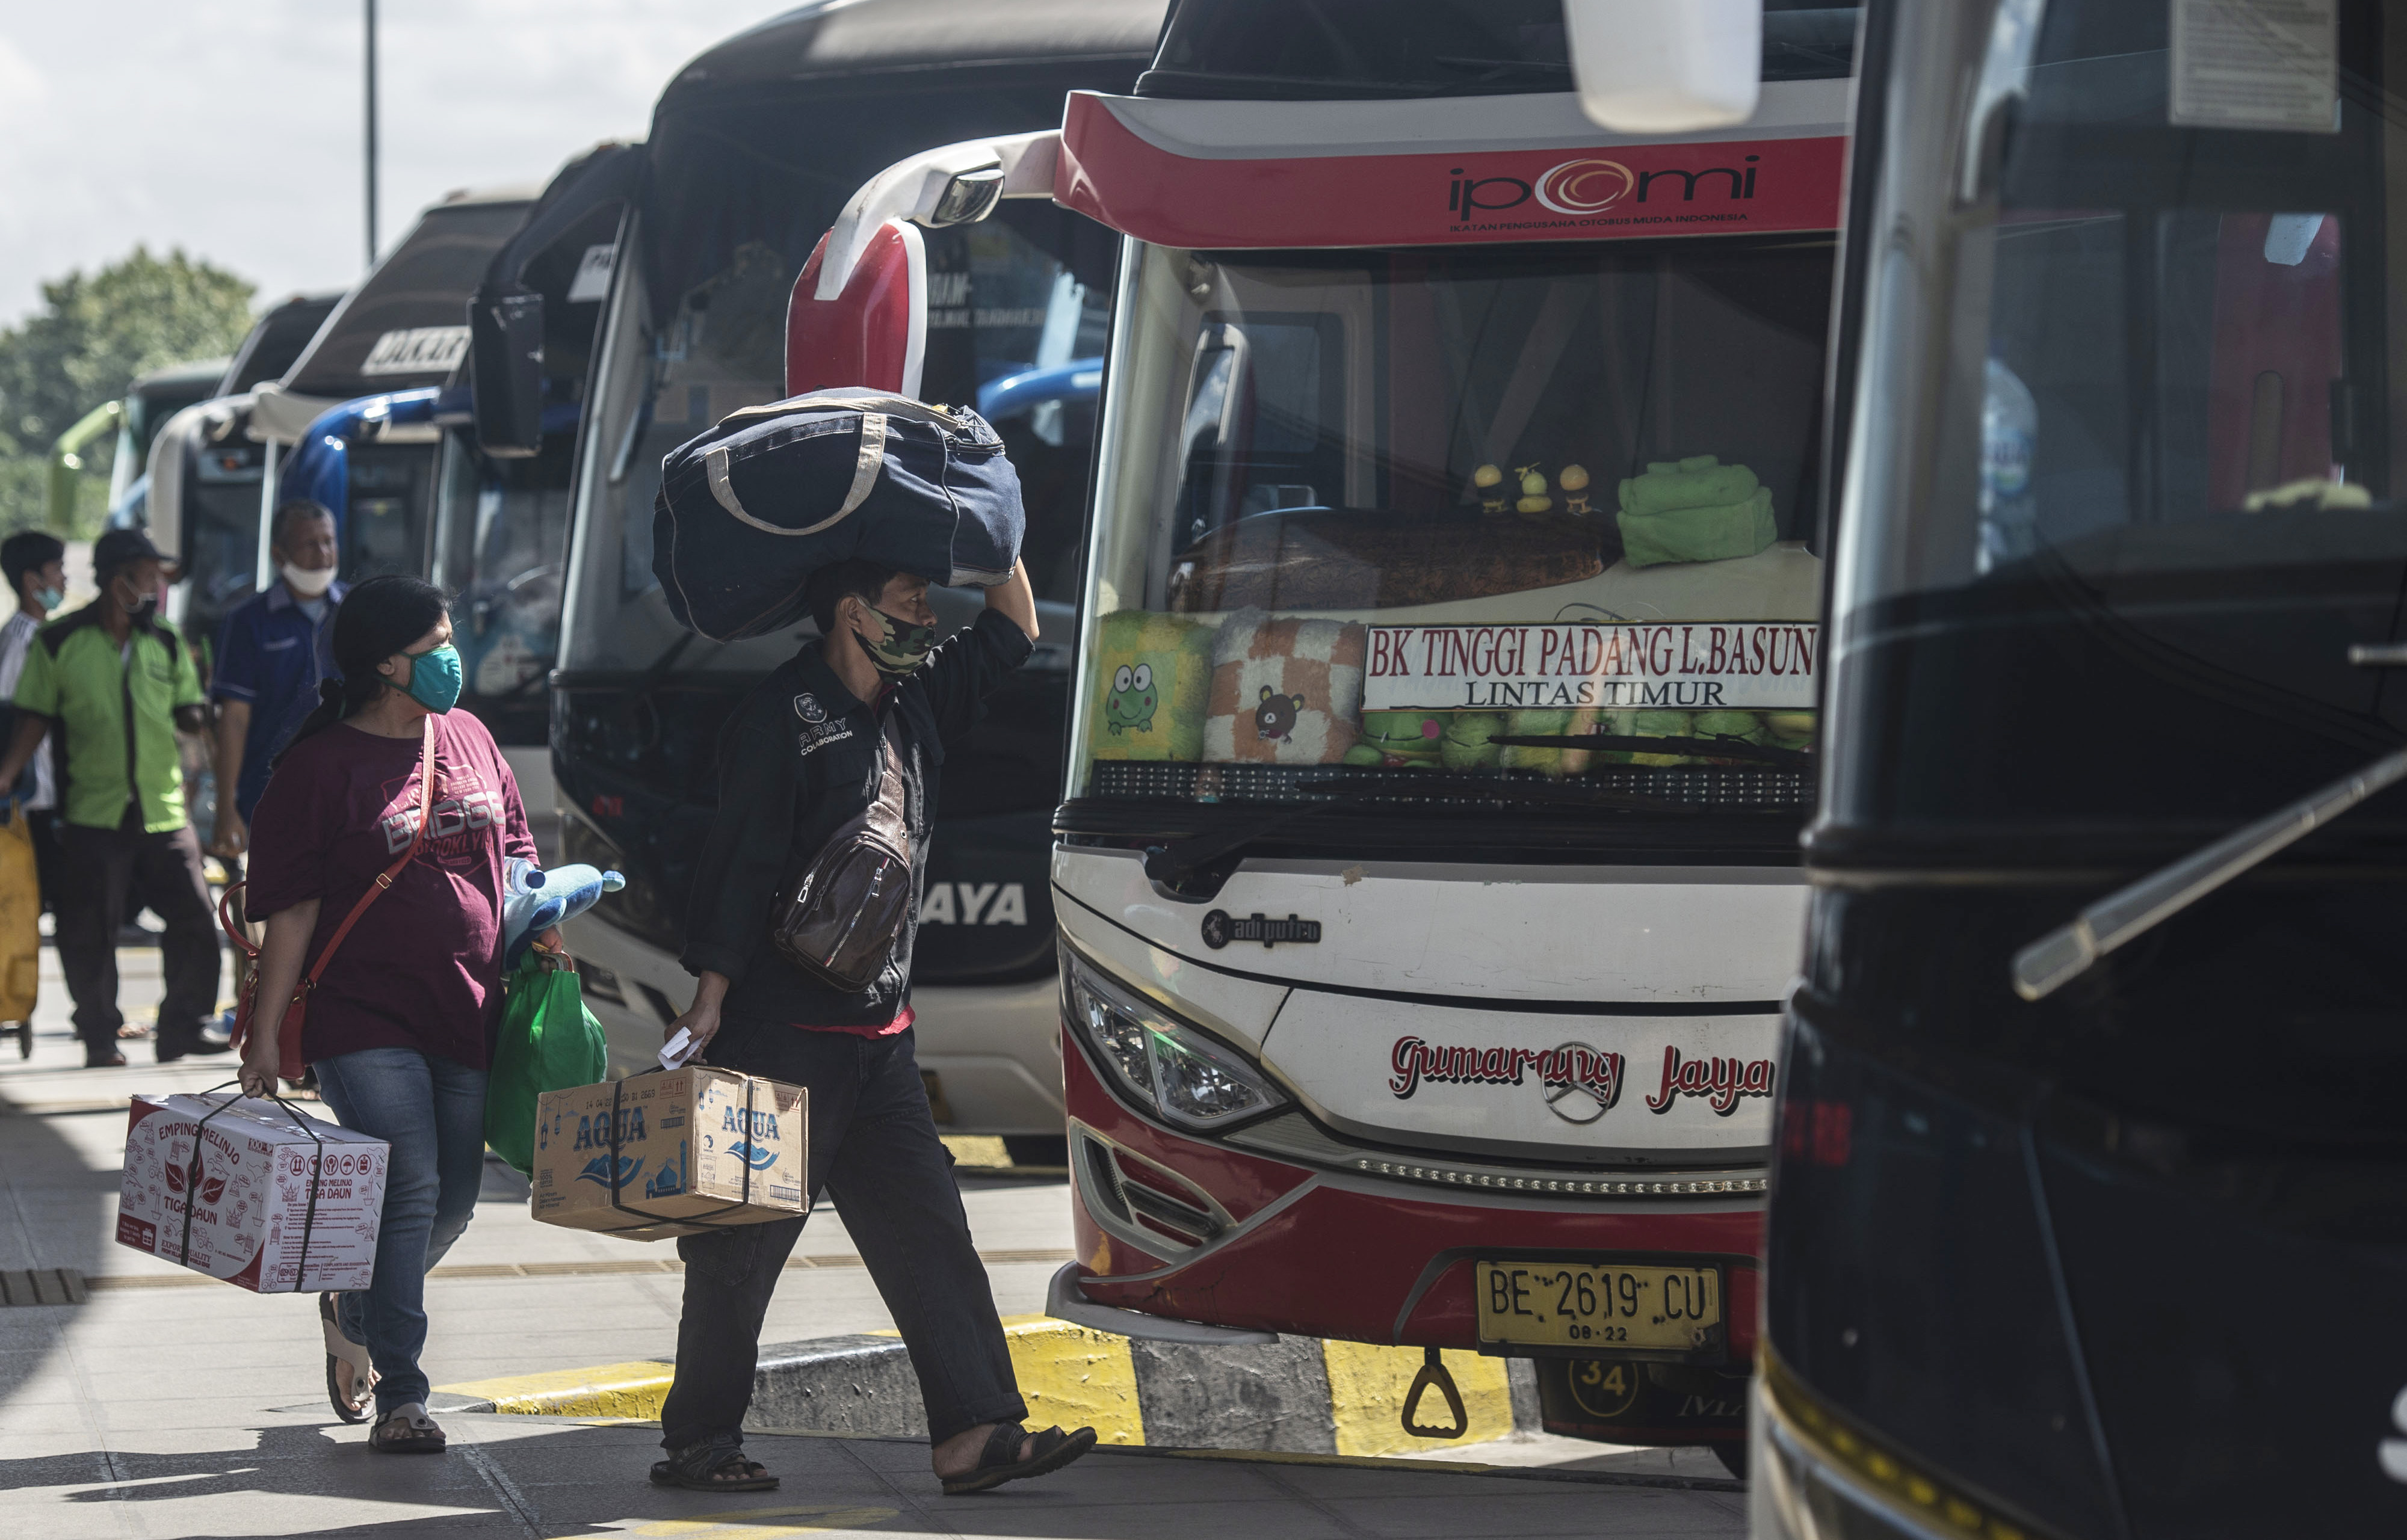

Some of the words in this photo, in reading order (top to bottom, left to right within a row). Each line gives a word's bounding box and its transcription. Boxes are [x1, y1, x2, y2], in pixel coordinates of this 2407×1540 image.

[1450, 223, 1498, 233] IKATAN
[1499, 218, 1577, 231] PENGUSAHA
[1578, 216, 1631, 227] OTOBUS
[1633, 215, 1673, 225] MUDA
[1675, 212, 1749, 223] INDONESIA
[1368, 629, 1415, 678] BK
[1422, 627, 1525, 677] TINGGI
[1540, 626, 1675, 677] PADANG
[1677, 626, 1820, 676] L.BASUN
[1465, 681, 1595, 706] LINTAS
[1604, 680, 1727, 705] TIMUR
[799, 718, 846, 747] ARMY
[1389, 1035, 1625, 1108] Gumarang
[1646, 1045, 1775, 1116] Jaya
[573, 1106, 647, 1152] AQUA
[722, 1105, 781, 1143] AQUA
[158, 1123, 199, 1141] EMPING
[201, 1126, 240, 1165] MELINJO
[327, 1187, 351, 1199] DAUN
[329, 1178, 353, 1187] MELINJO
[164, 1196, 187, 1214] TIGA
[190, 1205, 217, 1225] DAUN
[161, 1239, 182, 1253] EXPOR
[1490, 1269, 1533, 1316] BE
[1556, 1270, 1639, 1317] 2619
[1664, 1274, 1706, 1320] CU
[1581, 1360, 1625, 1396] 34
